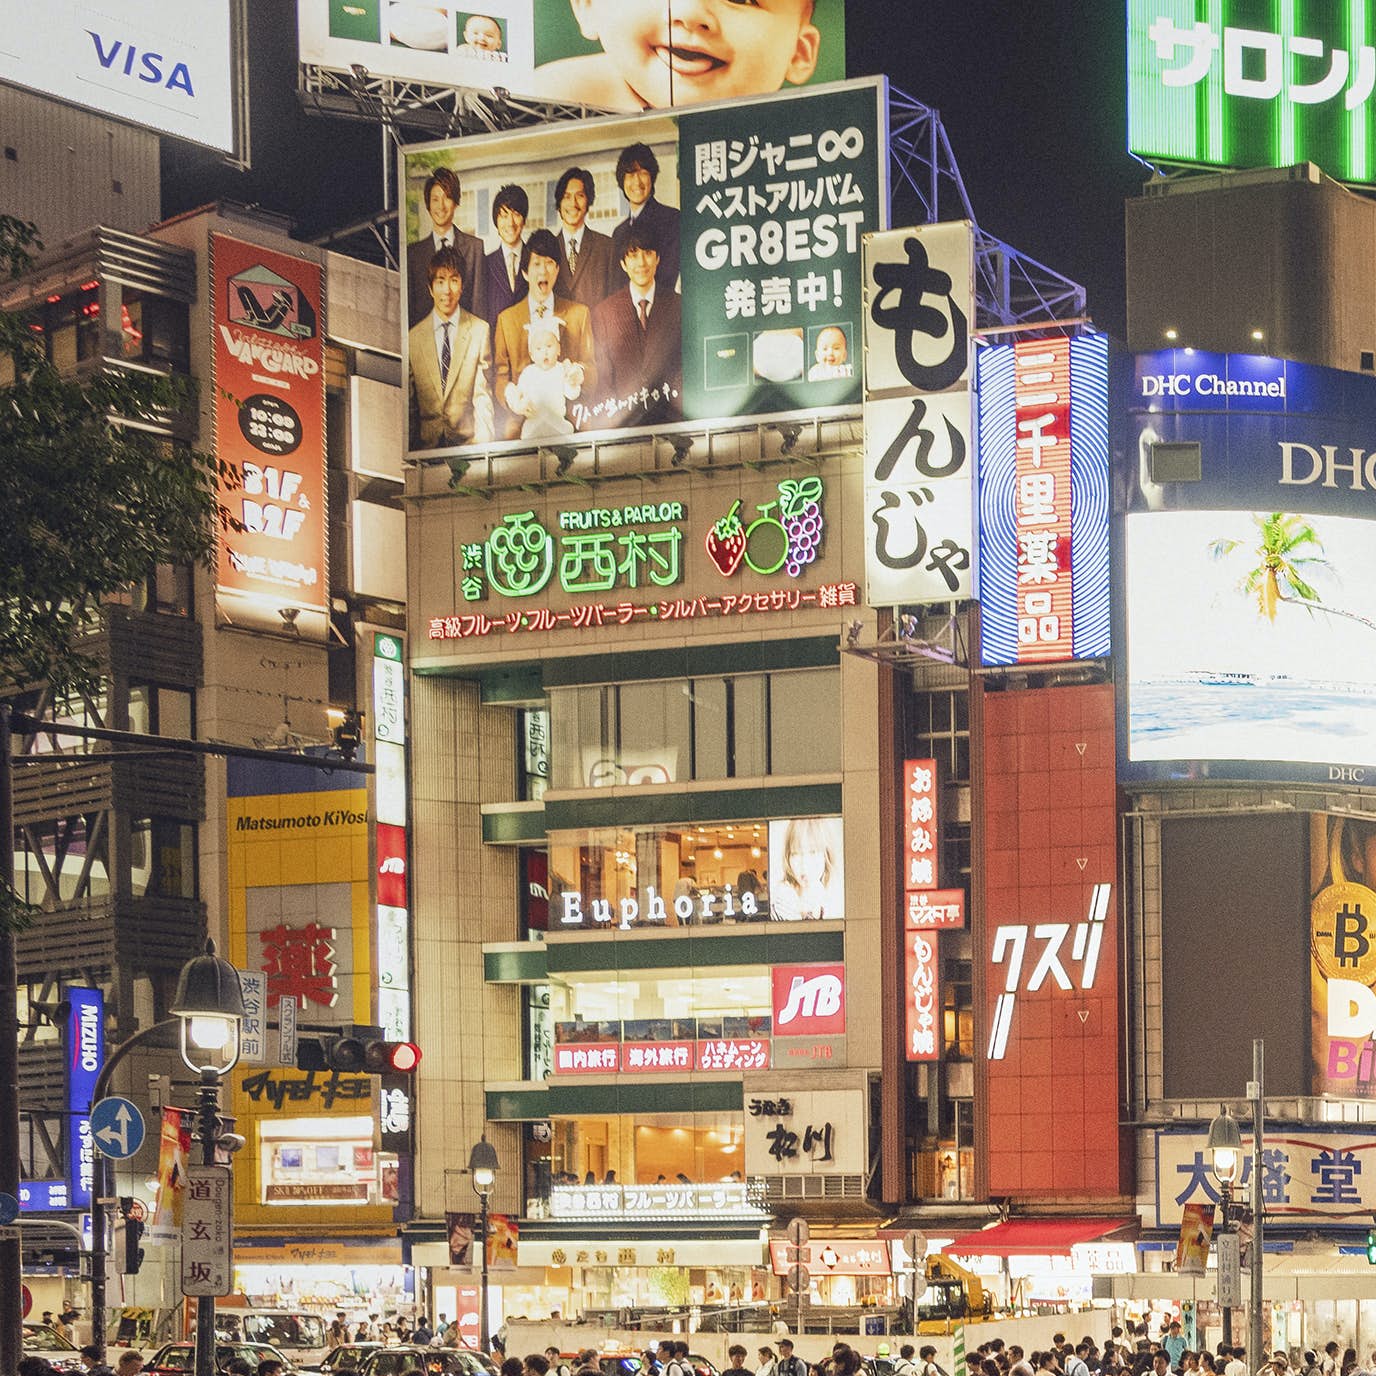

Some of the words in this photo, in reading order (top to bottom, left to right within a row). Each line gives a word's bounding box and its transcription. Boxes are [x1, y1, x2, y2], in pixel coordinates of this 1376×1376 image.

[83, 28, 195, 97] VISA
[694, 126, 865, 186] 関ジャニ∞
[695, 172, 865, 219] ベストアルバム
[695, 210, 865, 271] GR8EST
[219, 324, 319, 380] VANGUARD
[869, 236, 970, 593] もんじゃ
[1142, 374, 1191, 397] DHC
[1195, 374, 1287, 398] Channel
[1015, 352, 1061, 642] 三千里薬品
[460, 543, 483, 601] 渋谷
[559, 524, 682, 593] 西村
[1328, 765, 1365, 782] DHC
[236, 814, 321, 832] Matsumoto
[561, 885, 758, 930] Euphoria
[778, 974, 842, 1026] JTB
[987, 883, 1112, 1060] クスリ
[80, 1004, 99, 1072] MIZUHO
[242, 977, 260, 1056] 渋谷駅前
[558, 1048, 617, 1069] 国内旅行
[629, 1047, 689, 1068] 海外旅行
[704, 1041, 763, 1056] ハネムーン
[189, 1179, 212, 1283] 道玄坂
